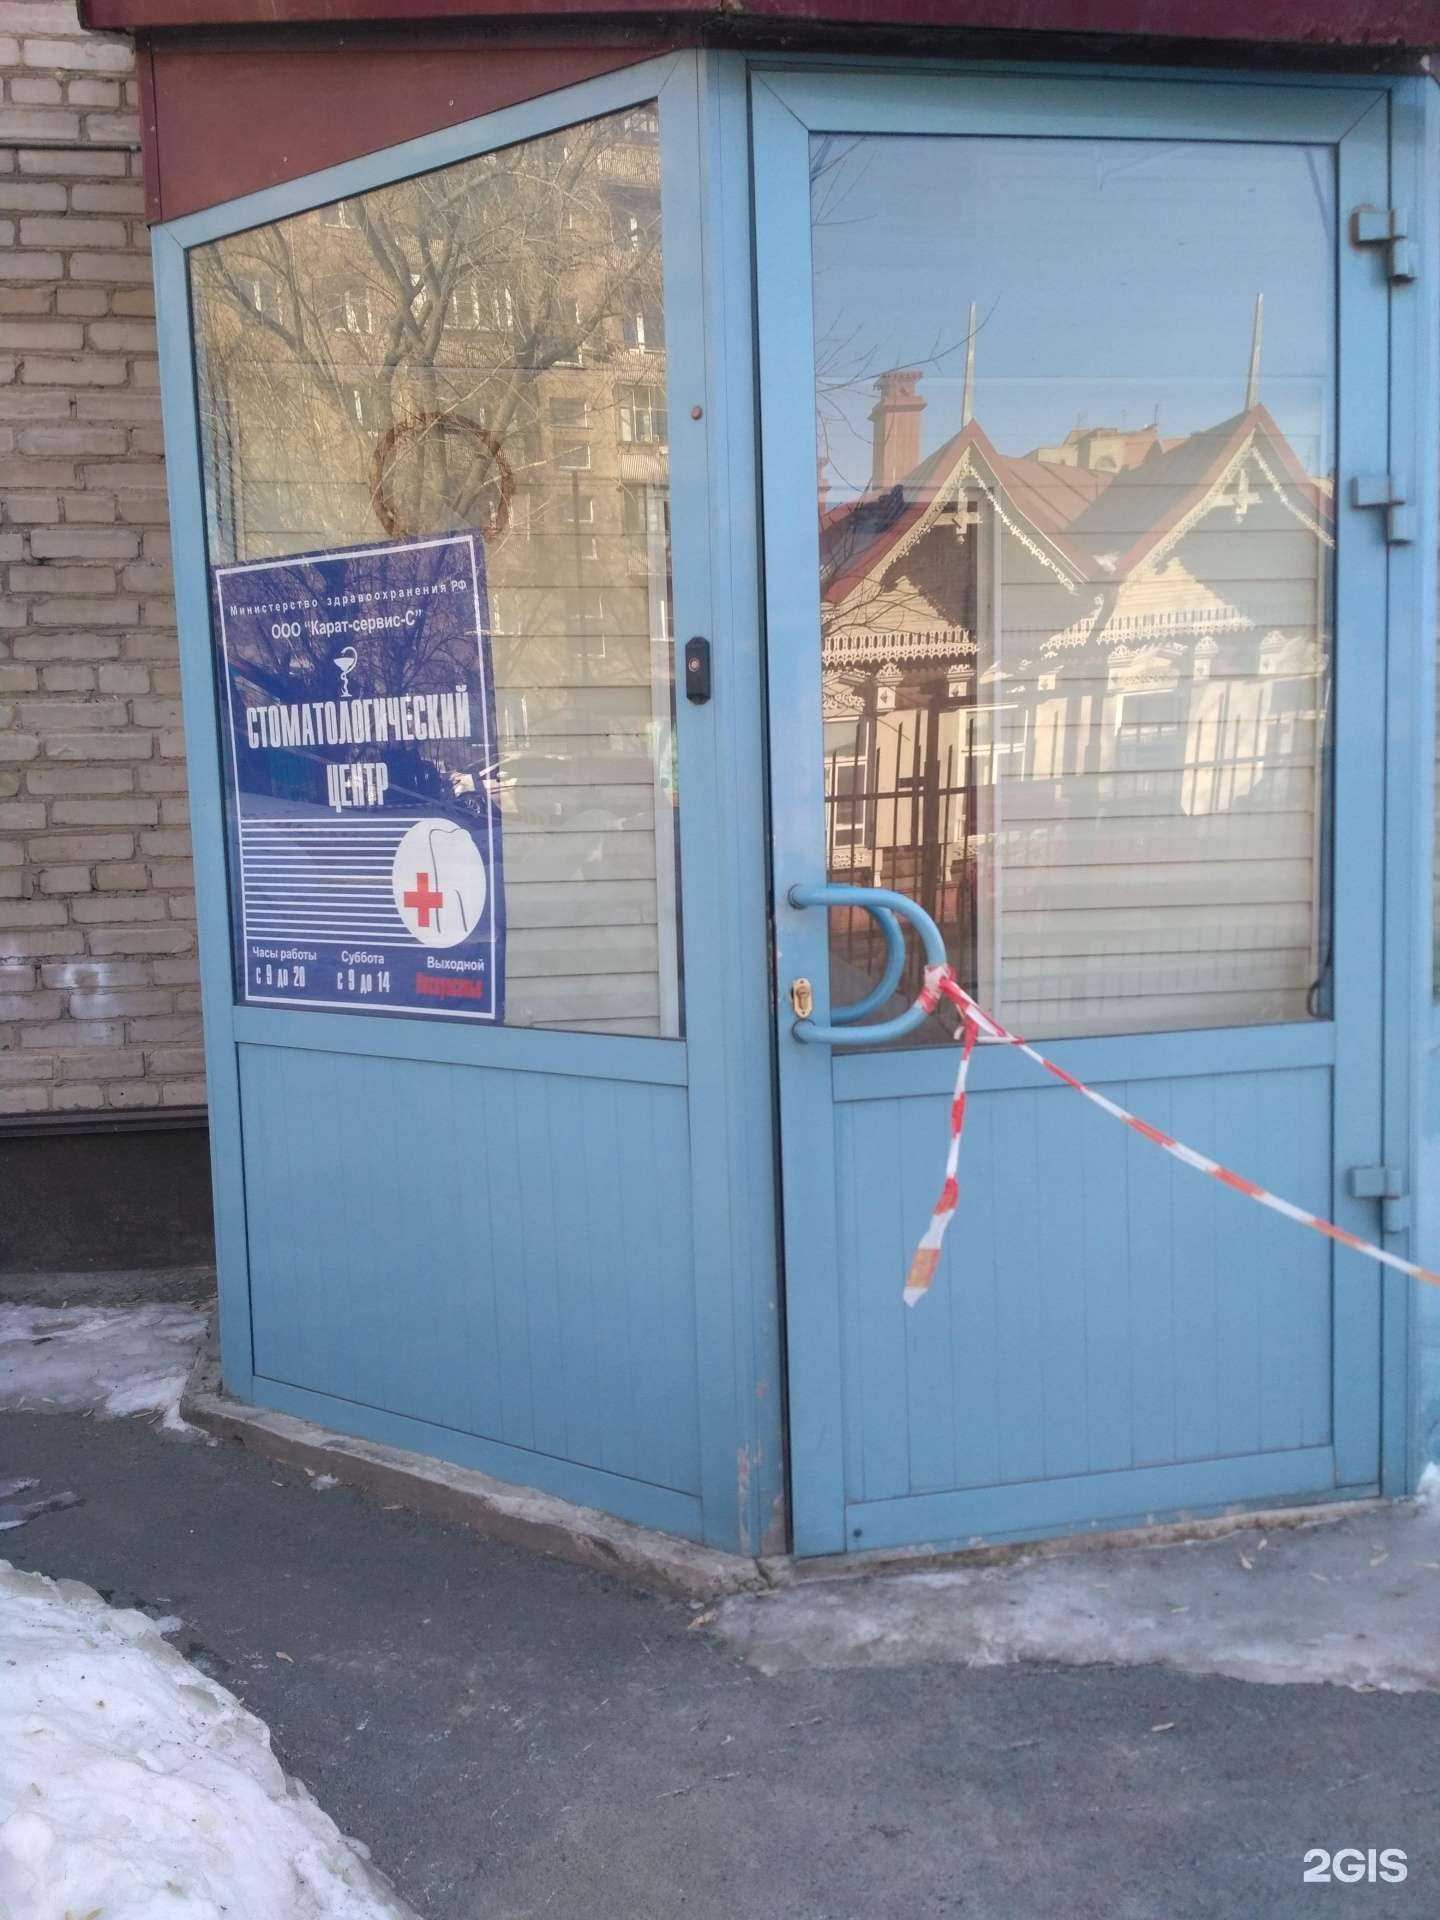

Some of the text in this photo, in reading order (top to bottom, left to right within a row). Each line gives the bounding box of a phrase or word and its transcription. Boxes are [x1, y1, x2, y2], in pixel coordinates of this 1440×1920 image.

[230, 579, 467, 617] Министерство здравоохранения РФ
[271, 622, 301, 640] ООО
[246, 684, 471, 749] СТОМАТОЛОГИЧЕСКИЙ
[326, 762, 389, 813] ЦЕНТР
[252, 946, 317, 962] Часы работы
[341, 950, 385, 966] Суббота
[426, 955, 485, 973] Выходной
[266, 963, 273, 986] 9
[277, 968, 289, 988] до
[293, 965, 306, 987] 20
[348, 968, 355, 991] 9
[360, 973, 372, 994] до
[377, 970, 390, 993] 14
